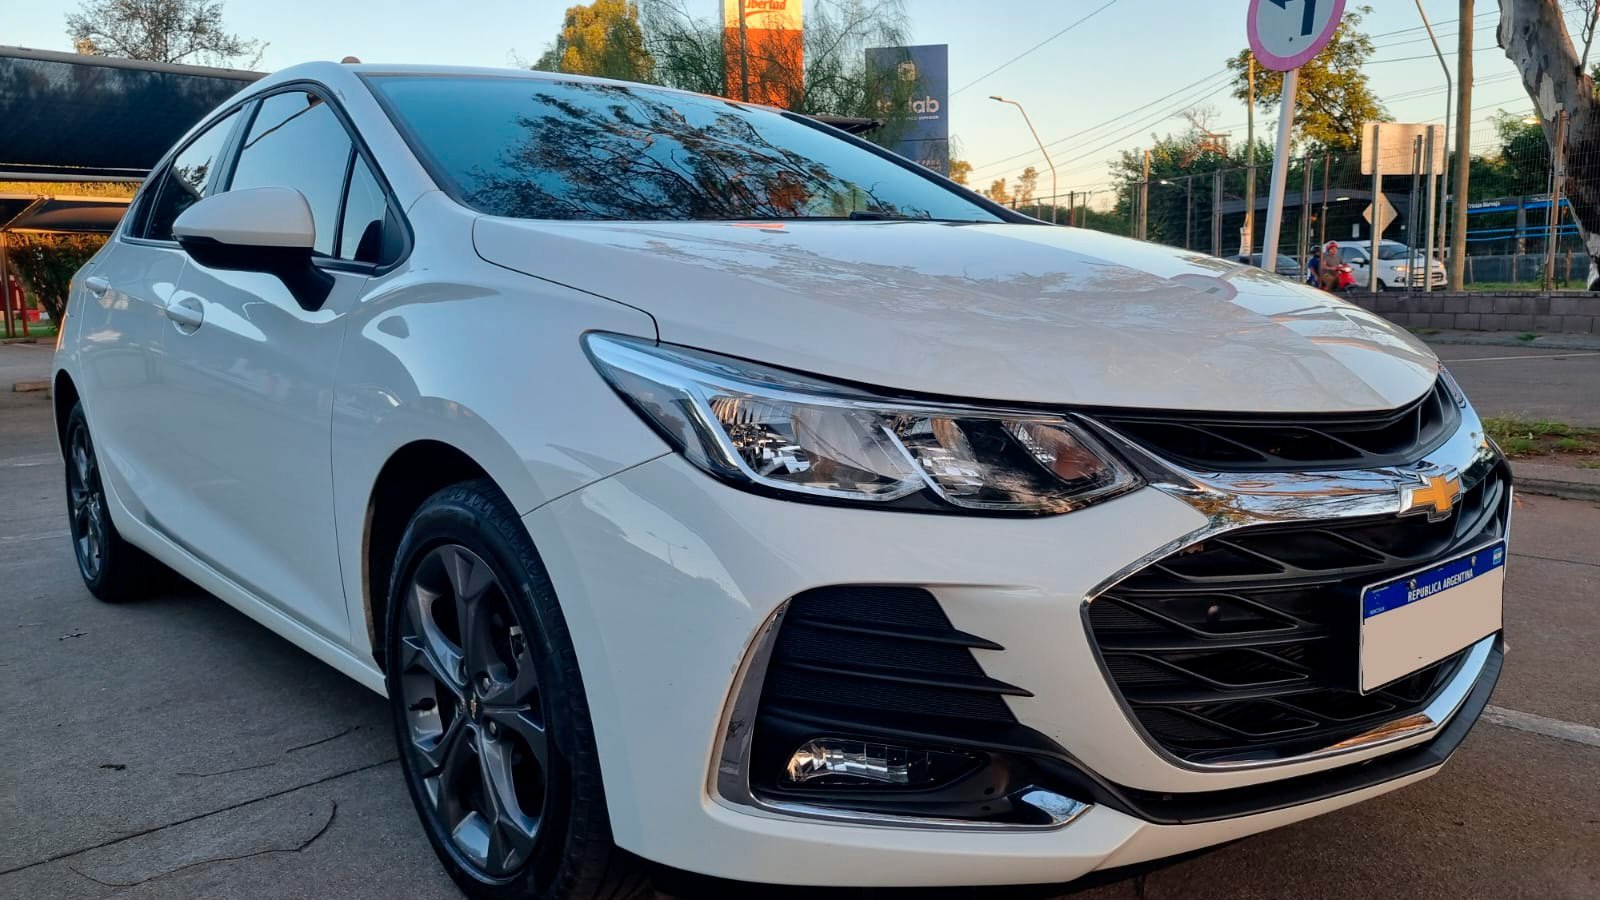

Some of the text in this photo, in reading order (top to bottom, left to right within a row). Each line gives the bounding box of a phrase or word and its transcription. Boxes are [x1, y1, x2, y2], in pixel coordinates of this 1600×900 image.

[744, 0, 787, 10] ibertad
[1407, 568, 1474, 602] REPUBLICA ARGENTINA
